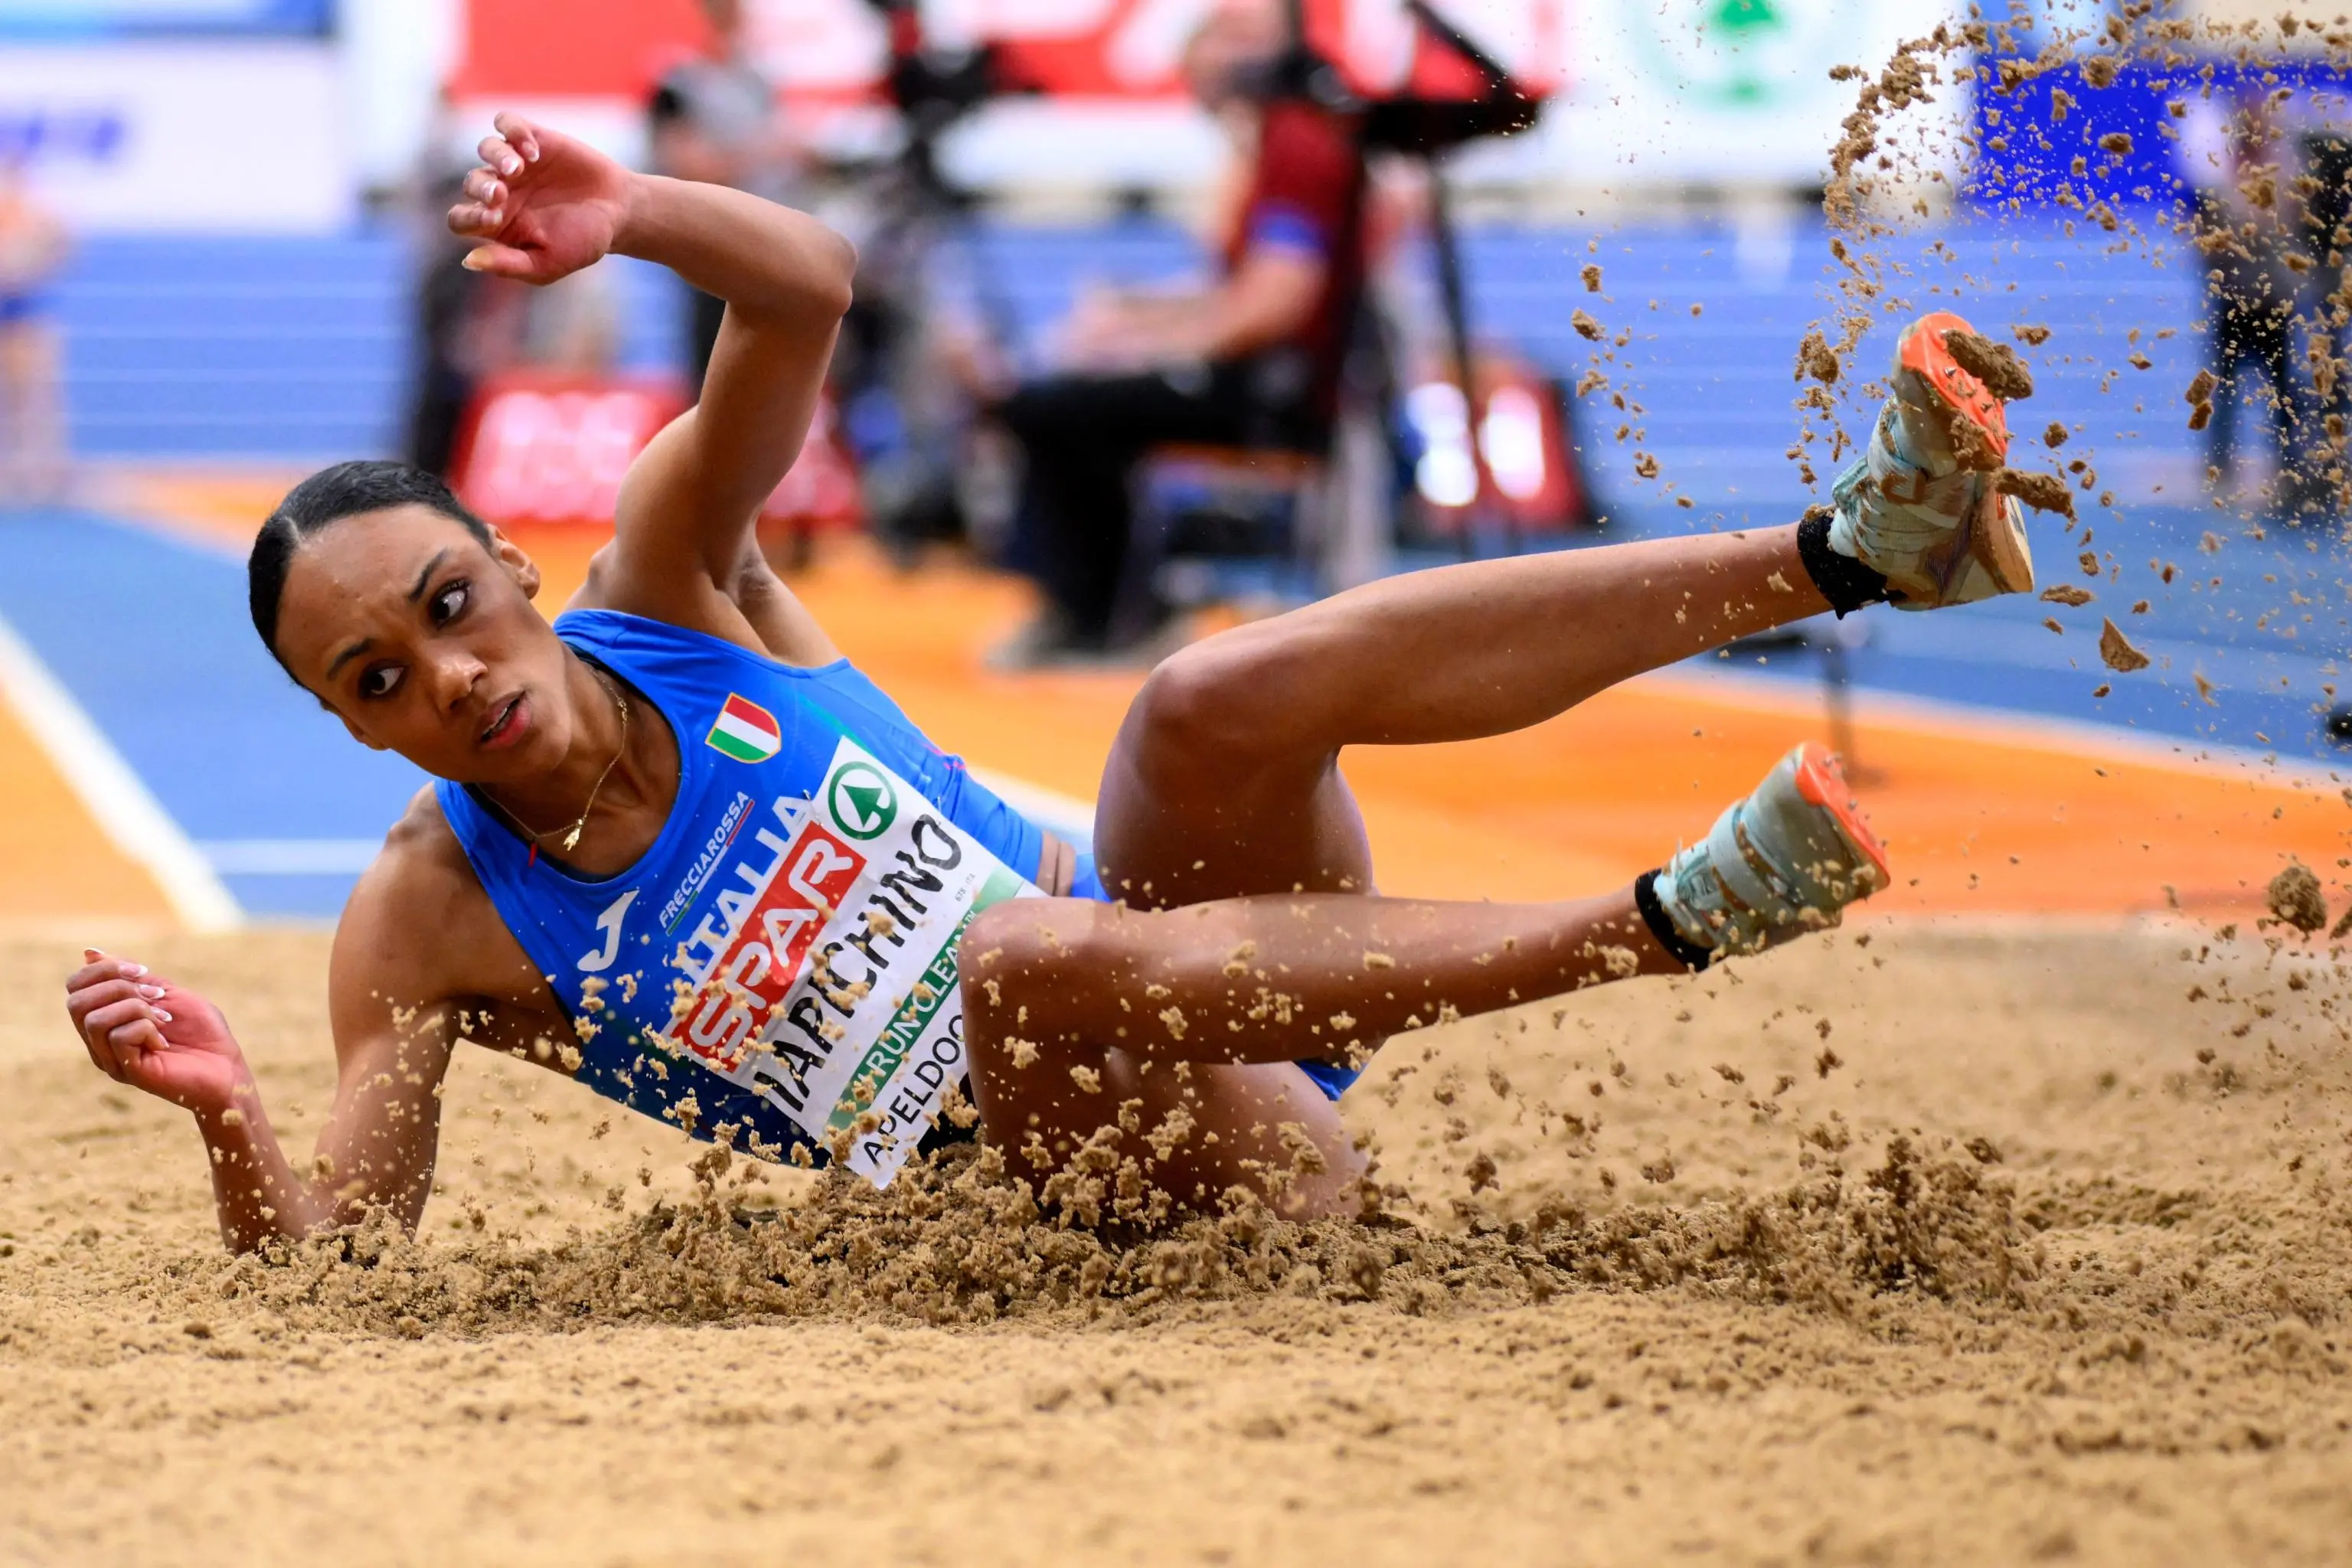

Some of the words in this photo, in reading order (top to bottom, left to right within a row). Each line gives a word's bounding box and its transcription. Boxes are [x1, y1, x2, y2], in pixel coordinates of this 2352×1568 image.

[659, 791, 749, 928] FRECCIAROSSA
[678, 795, 812, 984] ITALIA
[690, 838, 853, 1058] SPAR
[753, 813, 962, 1112] IAPICHINO
